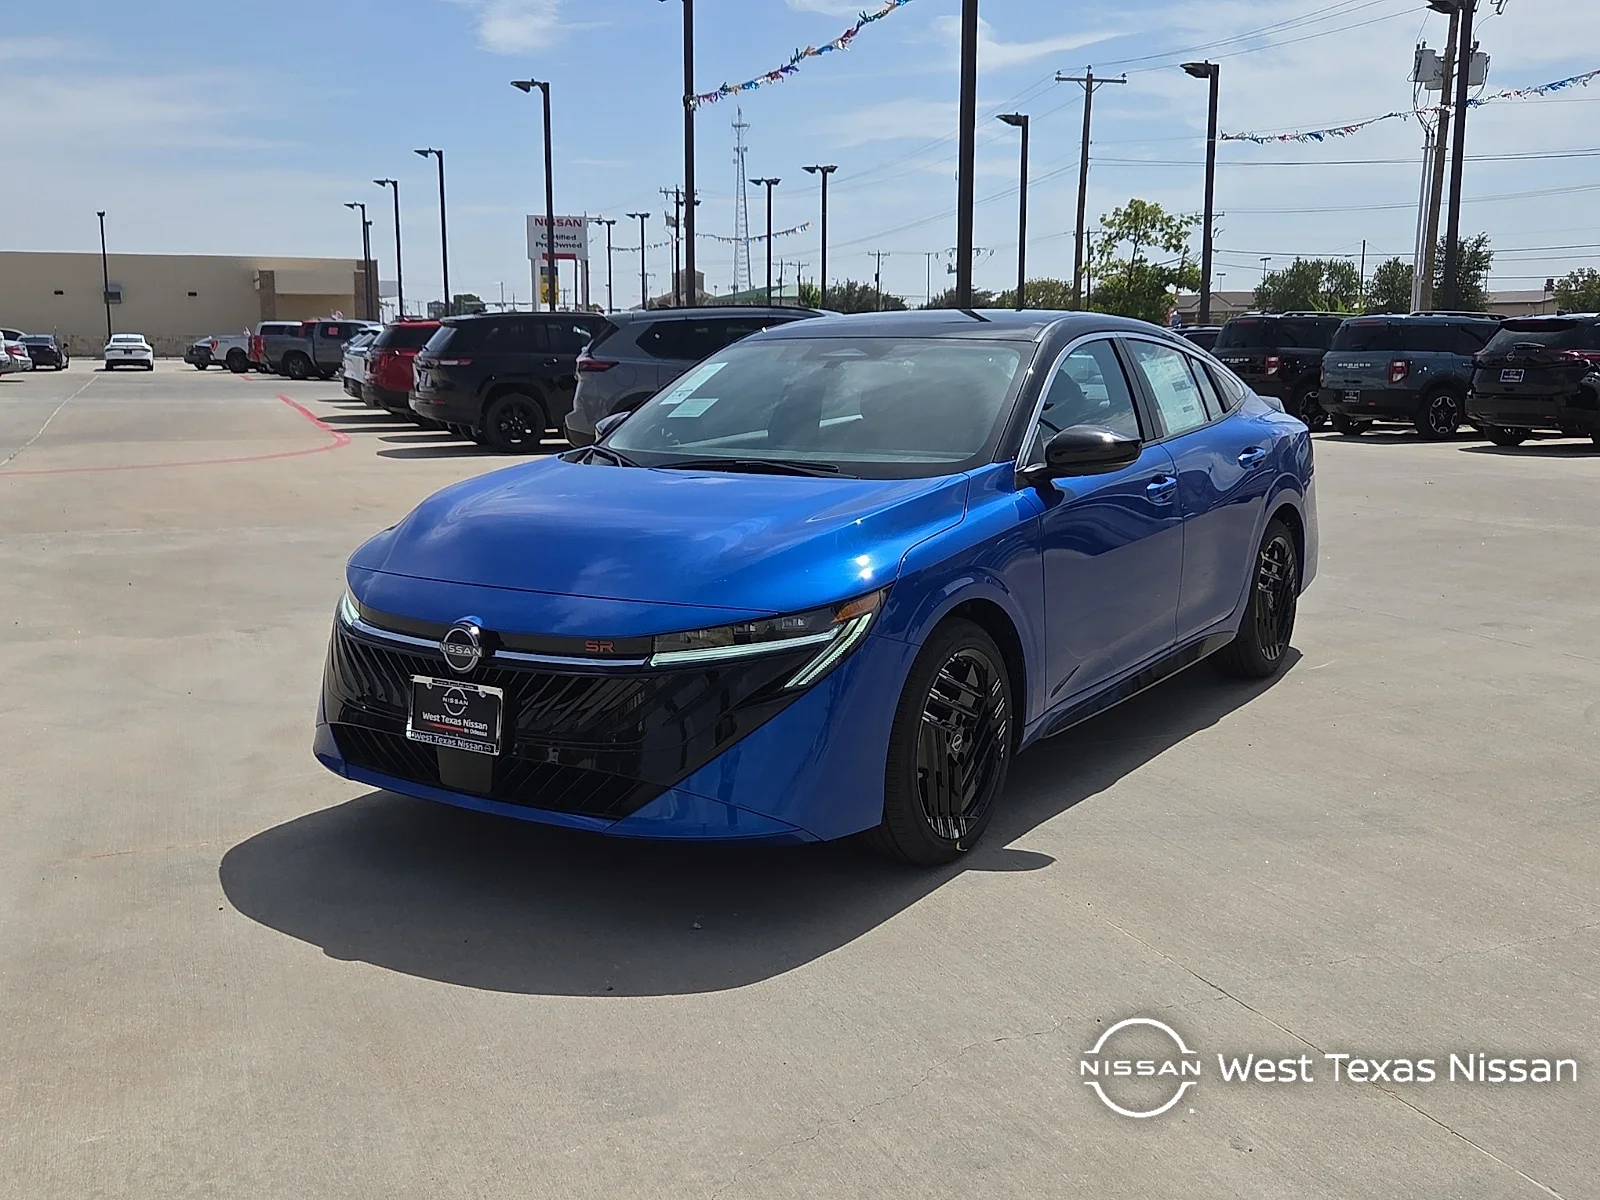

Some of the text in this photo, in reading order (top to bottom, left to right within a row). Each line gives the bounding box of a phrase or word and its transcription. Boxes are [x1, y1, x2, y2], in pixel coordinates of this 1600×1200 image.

[440, 642, 482, 657] NISSAN
[585, 640, 615, 652] SR
[442, 696, 468, 706] NISSAN
[422, 711, 488, 730] West Texas Nissan
[414, 731, 484, 751] West Texas Nissan
